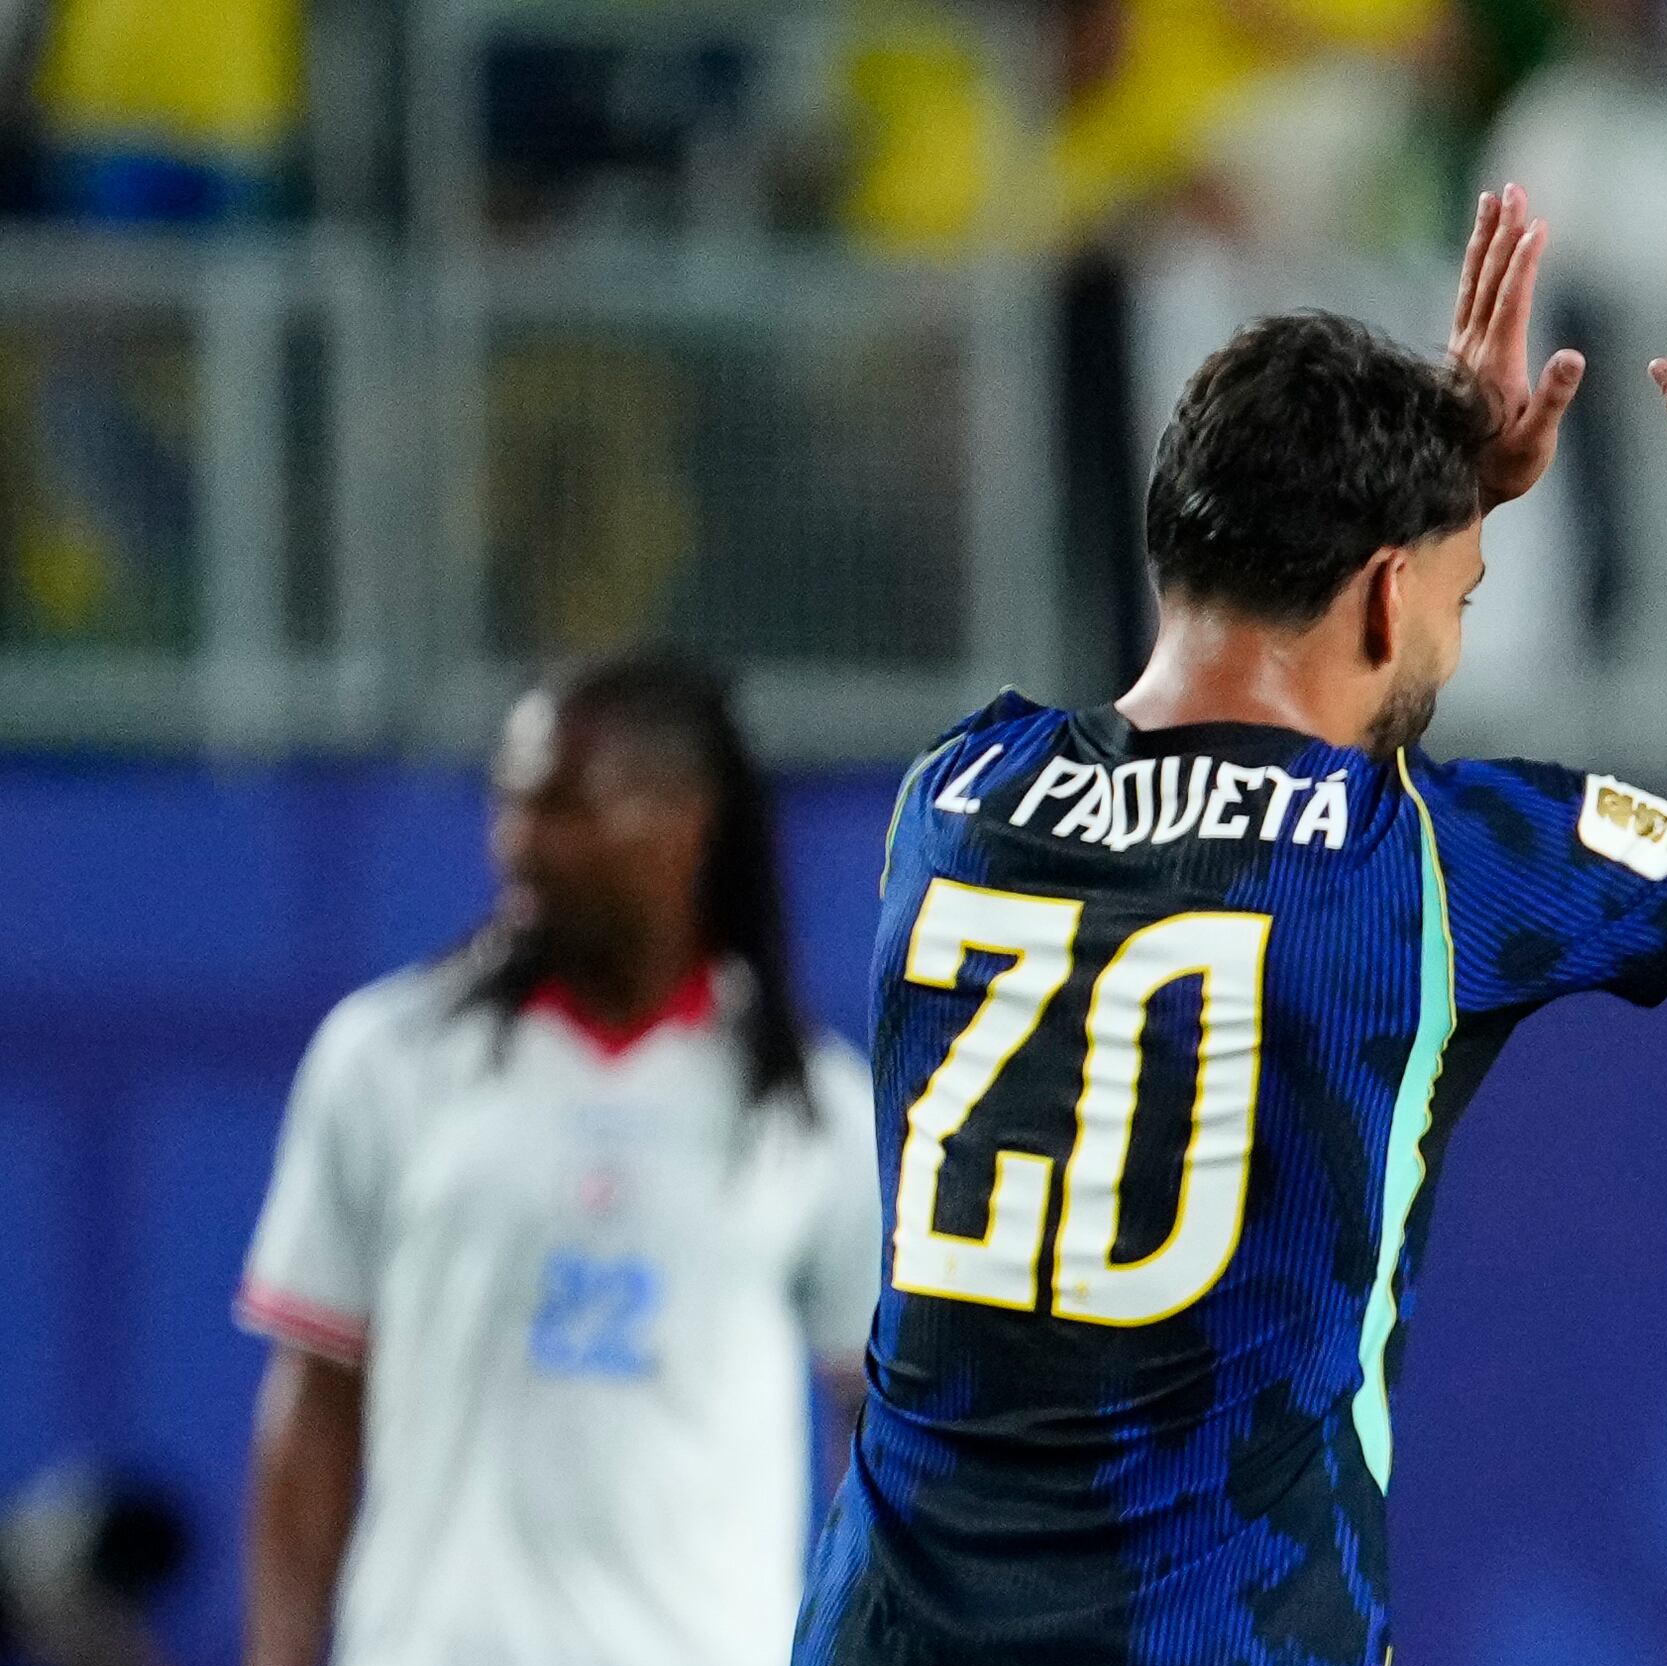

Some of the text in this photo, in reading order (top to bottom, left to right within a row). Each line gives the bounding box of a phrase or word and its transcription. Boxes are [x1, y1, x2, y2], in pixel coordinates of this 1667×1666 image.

[1008, 754, 1350, 853] PAQUETÁ
[891, 876, 1274, 1328] 20
[528, 1246, 666, 1380] 22
